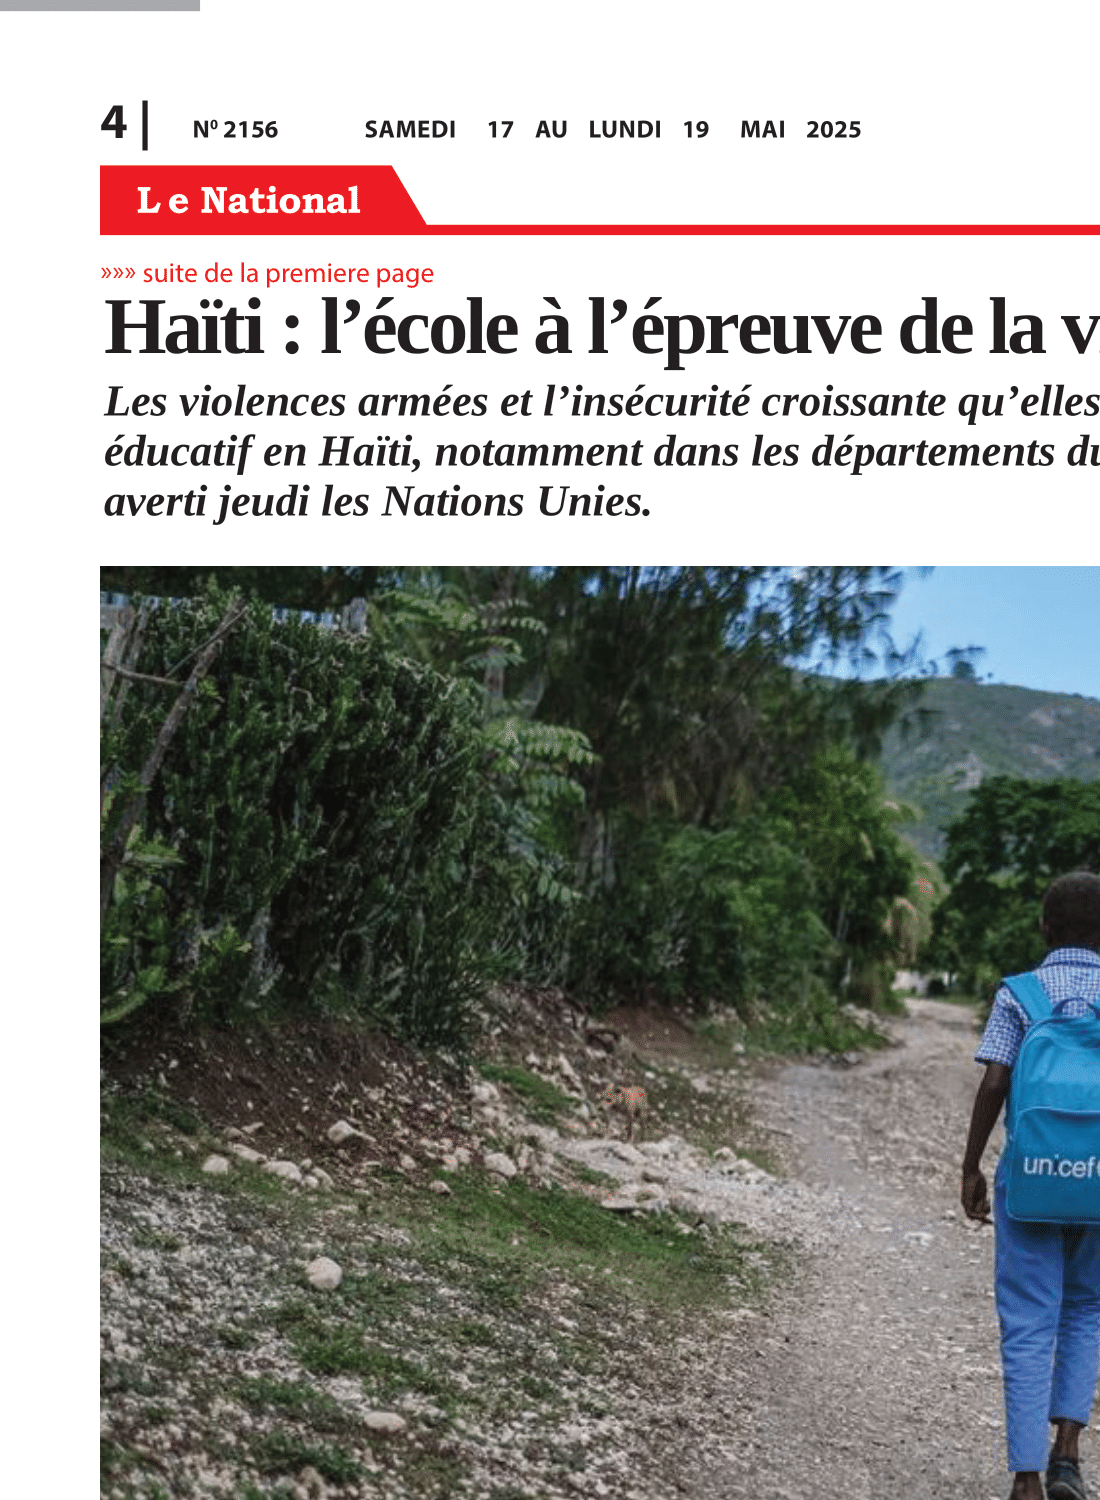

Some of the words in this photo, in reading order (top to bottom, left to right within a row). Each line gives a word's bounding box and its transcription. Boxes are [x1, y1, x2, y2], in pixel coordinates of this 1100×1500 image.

[101, 105, 127, 138] 4
[223, 121, 278, 138] 2156
[366, 120, 455, 138] SAMEDI
[489, 121, 513, 138] 17
[536, 121, 567, 138] AU
[590, 120, 660, 138] LUNDI
[684, 121, 709, 138] 19
[741, 121, 784, 138] MAI
[807, 121, 861, 138] 2025
[201, 186, 360, 213] National
[144, 263, 197, 282] suite
[205, 262, 233, 283] de
[241, 262, 258, 282] la
[267, 263, 369, 288] premiere
[377, 268, 434, 288] page
[105, 297, 264, 354] Haïti
[321, 297, 518, 354] l’école
[535, 297, 572, 354] à
[588, 297, 882, 370] l’épreuve
[900, 297, 973, 354] de
[989, 297, 1046, 354] la
[104, 386, 166, 416] Les
[179, 385, 345, 416] violences
[358, 384, 487, 416] armées
[501, 390, 533, 416] et
[544, 384, 752, 416] l’insécurité
[762, 385, 946, 416] croissante
[958, 385, 1100, 425] qu’elles
[105, 434, 255, 475] éducatif
[264, 444, 306, 466] en
[318, 435, 420, 472] Haïti,
[435, 440, 643, 466] notamment
[654, 435, 738, 466] dans
[752, 435, 799, 466] les
[812, 434, 1054, 475] départements
[104, 485, 207, 516] averti
[213, 485, 310, 525] jeudi
[322, 485, 369, 516] les
[381, 485, 523, 516] Nations
[540, 485, 650, 516] Unies.
